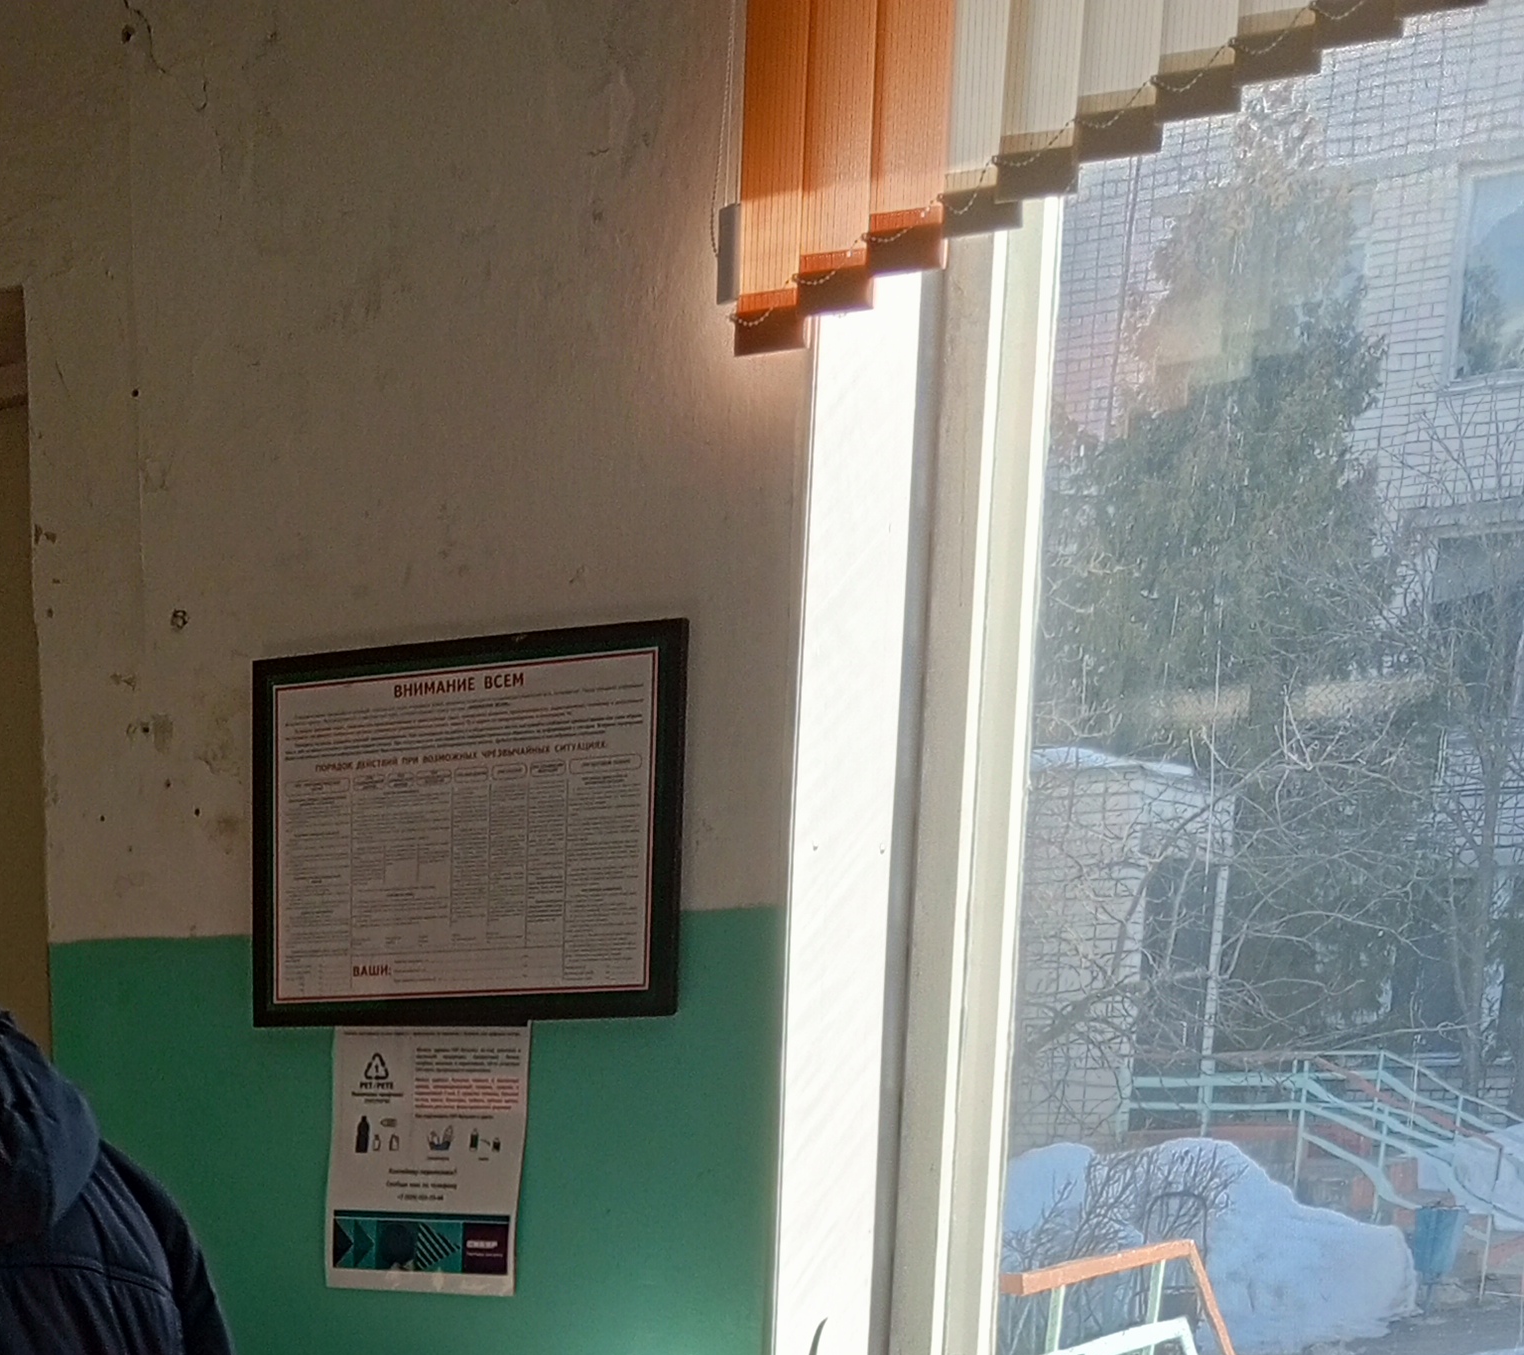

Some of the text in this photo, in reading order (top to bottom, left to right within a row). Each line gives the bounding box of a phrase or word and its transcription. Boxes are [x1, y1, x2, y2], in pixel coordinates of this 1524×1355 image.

[393, 672, 525, 699] ВНИМАНИЕ ВСЕМ
[352, 964, 392, 978] ВАШИ:
